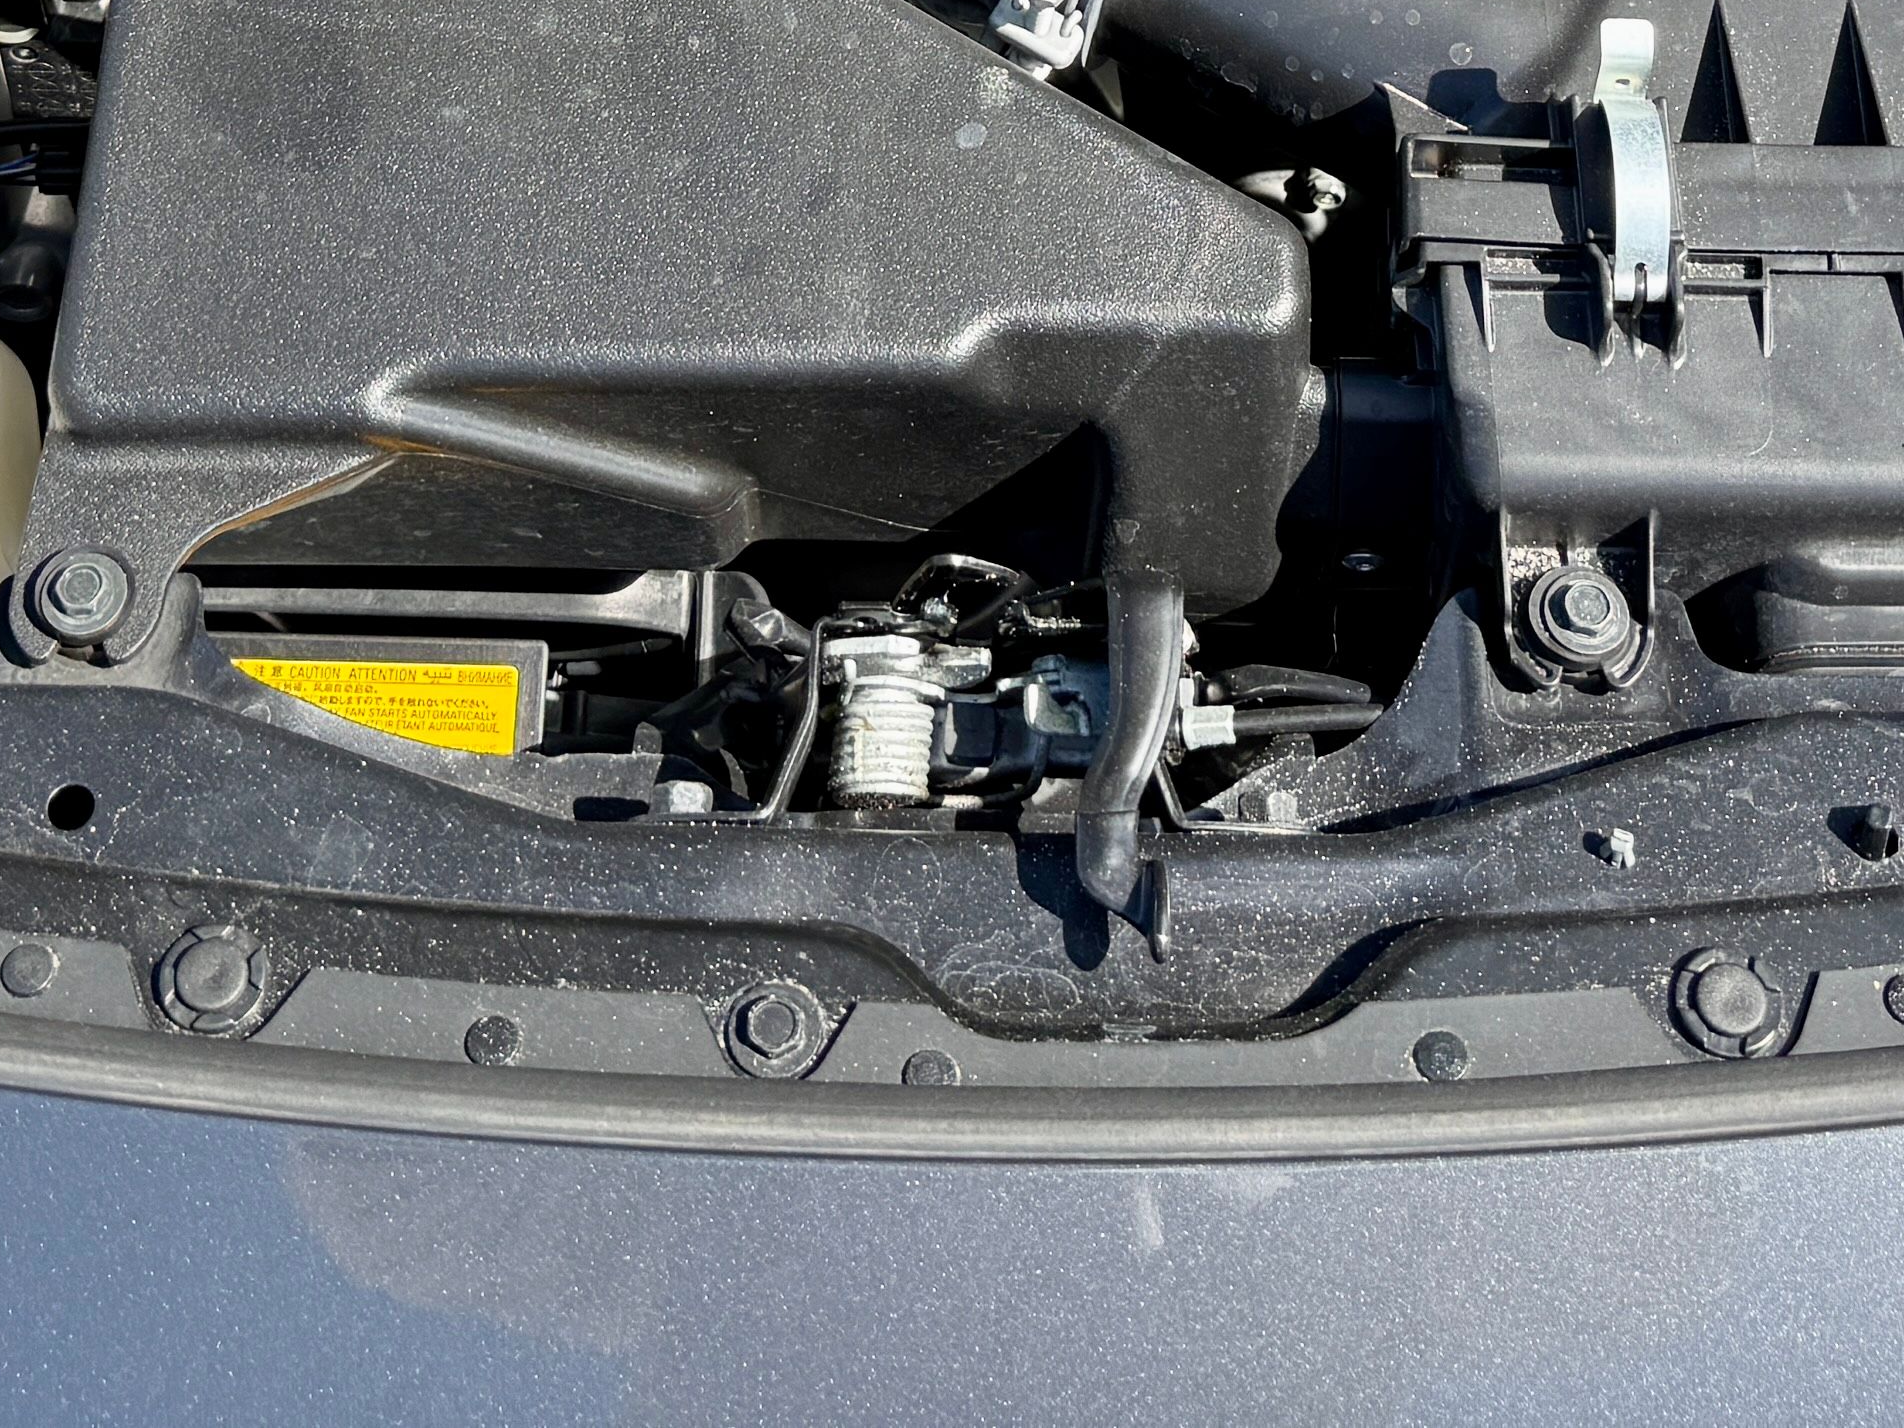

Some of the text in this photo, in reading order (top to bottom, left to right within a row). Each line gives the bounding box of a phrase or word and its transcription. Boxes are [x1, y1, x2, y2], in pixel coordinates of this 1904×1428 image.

[290, 666, 340, 679] CAUTION
[349, 667, 416, 682] ATTENTION
[345, 708, 365, 717] FAN
[368, 709, 407, 718] STARTS
